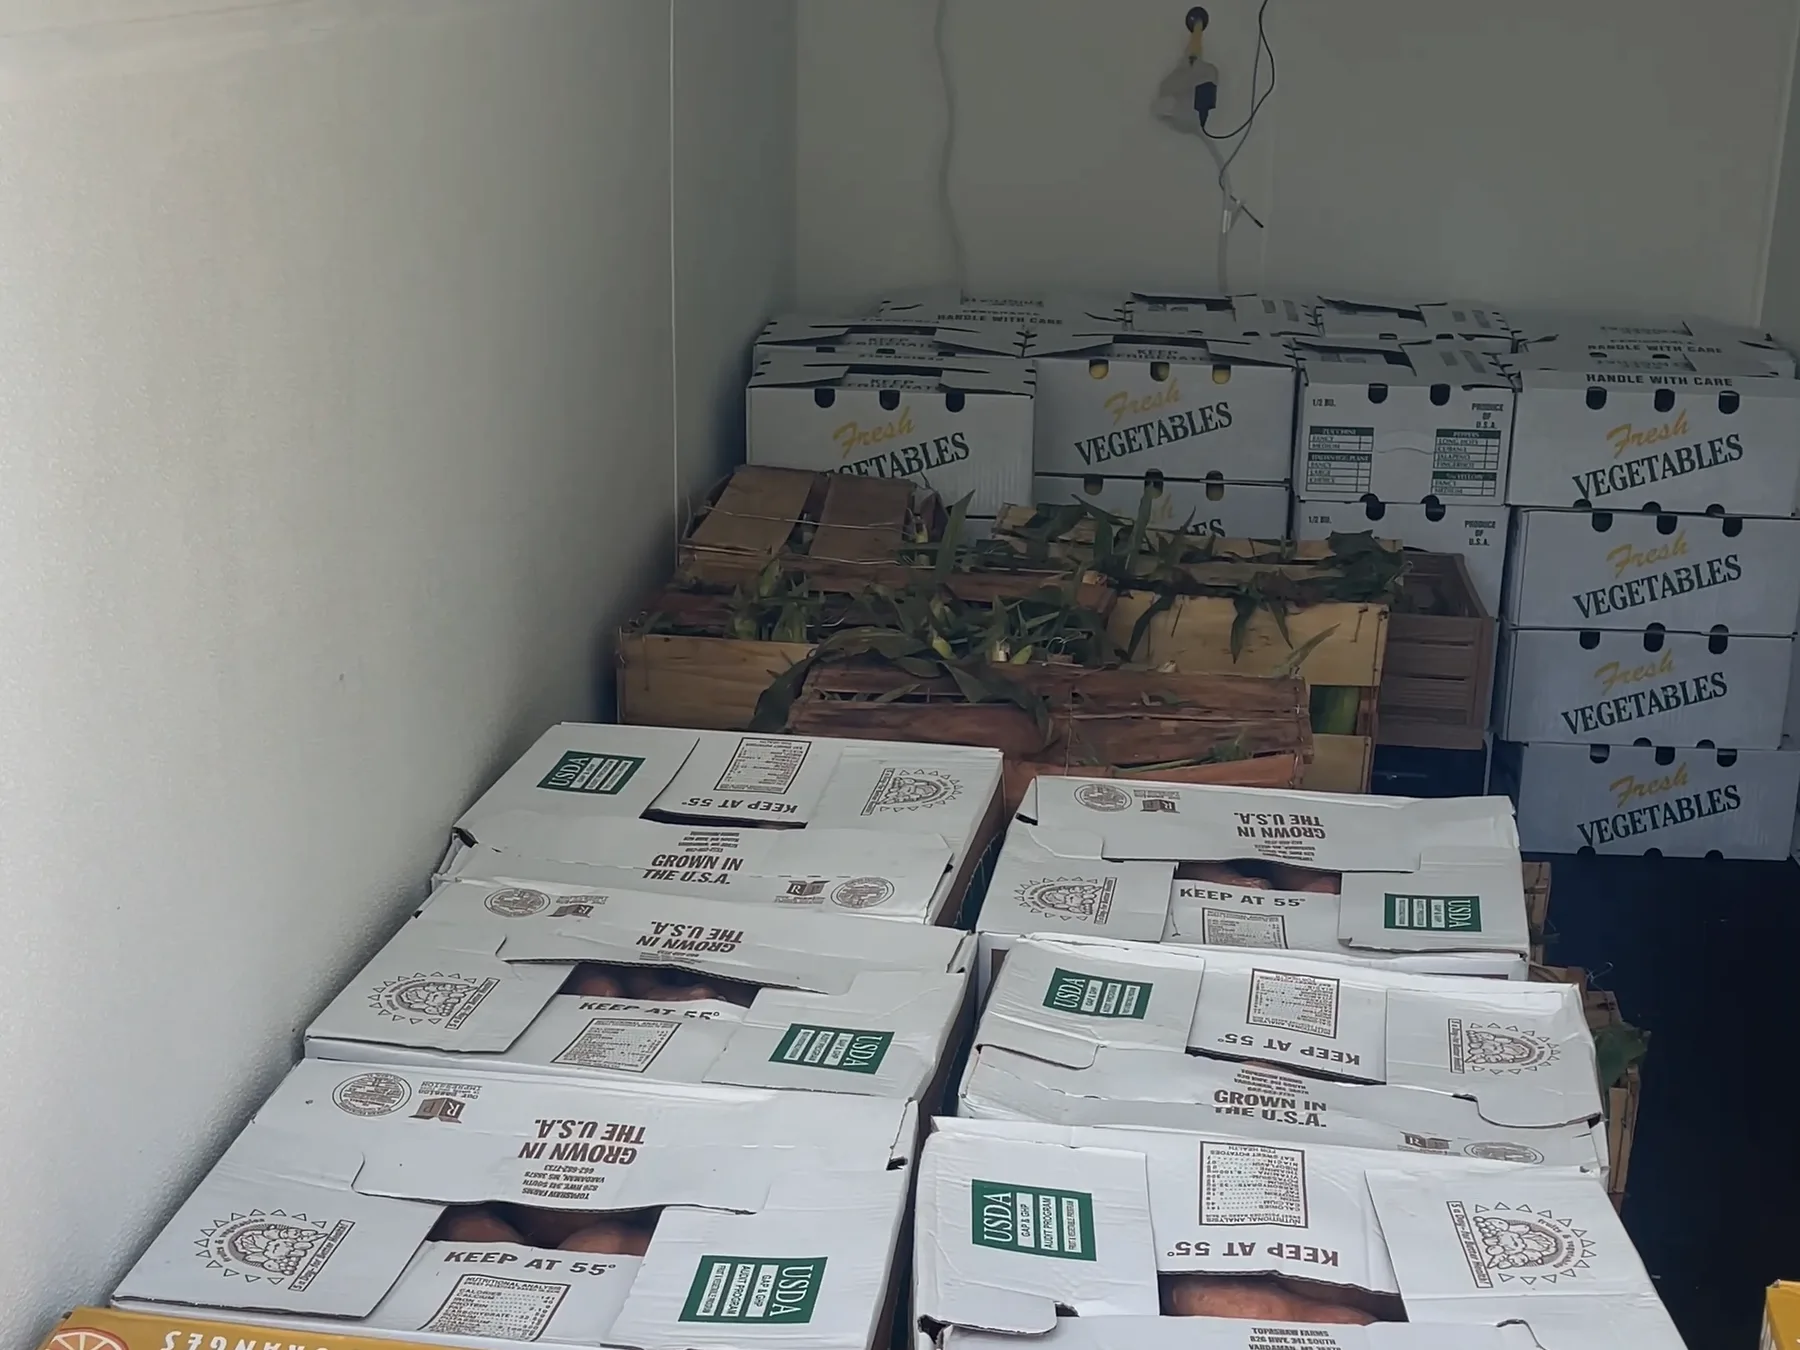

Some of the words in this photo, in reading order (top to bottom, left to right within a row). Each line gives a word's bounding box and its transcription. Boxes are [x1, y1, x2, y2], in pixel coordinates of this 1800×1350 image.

[937, 314, 986, 322] HANDLE
[1648, 345, 1682, 353] WITH
[1586, 373, 1644, 384] HANDLE
[1649, 376, 1688, 385] WITH
[1693, 377, 1733, 387] CARE
[1104, 377, 1180, 426] Fresh
[1471, 403, 1504, 411] PRODUCE
[832, 405, 915, 460] Fresh
[1074, 402, 1233, 466] VEGETABLES
[1606, 408, 1690, 460] Fresh
[1571, 433, 1744, 500] VEGETABLES
[1308, 516, 1319, 524] 1/2
[1320, 516, 1332, 524] BU.
[1464, 520, 1497, 529] PRODUCE
[1475, 529, 1484, 537] OF
[1469, 538, 1490, 546] U.S.A.
[1605, 528, 1688, 579] Fresh
[1572, 553, 1743, 619] VEGETABLES
[1593, 647, 1676, 697] Fresh
[1561, 671, 1728, 735] VEGETABLES
[547, 757, 590, 786] USDA
[1609, 761, 1690, 809] Fresh
[717, 799, 743, 809] AT
[747, 801, 799, 814] KEEP
[1234, 812, 1285, 825] U.S.A.
[1289, 813, 1325, 828] THE
[1577, 784, 1742, 847] VEGETABLES
[1237, 826, 1257, 837] IN
[1261, 826, 1326, 839] GROWN
[651, 854, 720, 869] GROWN
[721, 857, 744, 871] IN
[642, 869, 680, 880] THE
[680, 871, 730, 885] U.S.A.
[1180, 888, 1233, 901] KEEP
[1240, 895, 1266, 906] AT
[1447, 899, 1472, 928] USDA
[651, 921, 704, 939] U.S.A.
[706, 928, 744, 943] THE
[636, 936, 661, 947] IN
[662, 938, 736, 953] GROWN
[1053, 977, 1086, 1008] USDA
[843, 1035, 883, 1066] USDA
[1263, 1038, 1293, 1052] AT
[1300, 1049, 1361, 1066] KEEP
[424, 1101, 436, 1112] P
[1214, 1089, 1296, 1109] GROWN
[1304, 1100, 1327, 1112] IN
[447, 1102, 460, 1116] R
[1215, 1106, 1255, 1117] THE
[1262, 1109, 1327, 1127] U.S.A.
[535, 1119, 598, 1138] U.S.A.
[601, 1123, 646, 1144] THE
[518, 1142, 547, 1159] IN
[549, 1143, 637, 1165] GROWN
[523, 1179, 549, 1187] SOUTH
[564, 1173, 605, 1183] VARDAMAN,
[522, 1187, 549, 1197] FARMS
[983, 1192, 1012, 1242] USDA
[1020, 1203, 1031, 1218] GHP
[1042, 1197, 1054, 1230] PROGRAM
[1021, 1223, 1031, 1238] GAP
[1044, 1230, 1055, 1249] AUDIT
[1167, 1241, 1209, 1257] 55°
[1222, 1241, 1256, 1257] AT
[1267, 1243, 1339, 1268] KEEP
[444, 1251, 518, 1264] KEEP
[524, 1258, 562, 1270] AT
[569, 1262, 617, 1276] 55°
[737, 1265, 751, 1284] AUDIT
[760, 1275, 772, 1287] GAP
[460, 1288, 502, 1296] CALORIES
[466, 1277, 520, 1288] NUTRITIONAL
[521, 1283, 563, 1291] ANALYSIS
[769, 1264, 815, 1317] USDA
[727, 1284, 745, 1314] PROGRAM
[753, 1295, 767, 1307] GHP
[1300, 1329, 1329, 1337] FARMS
